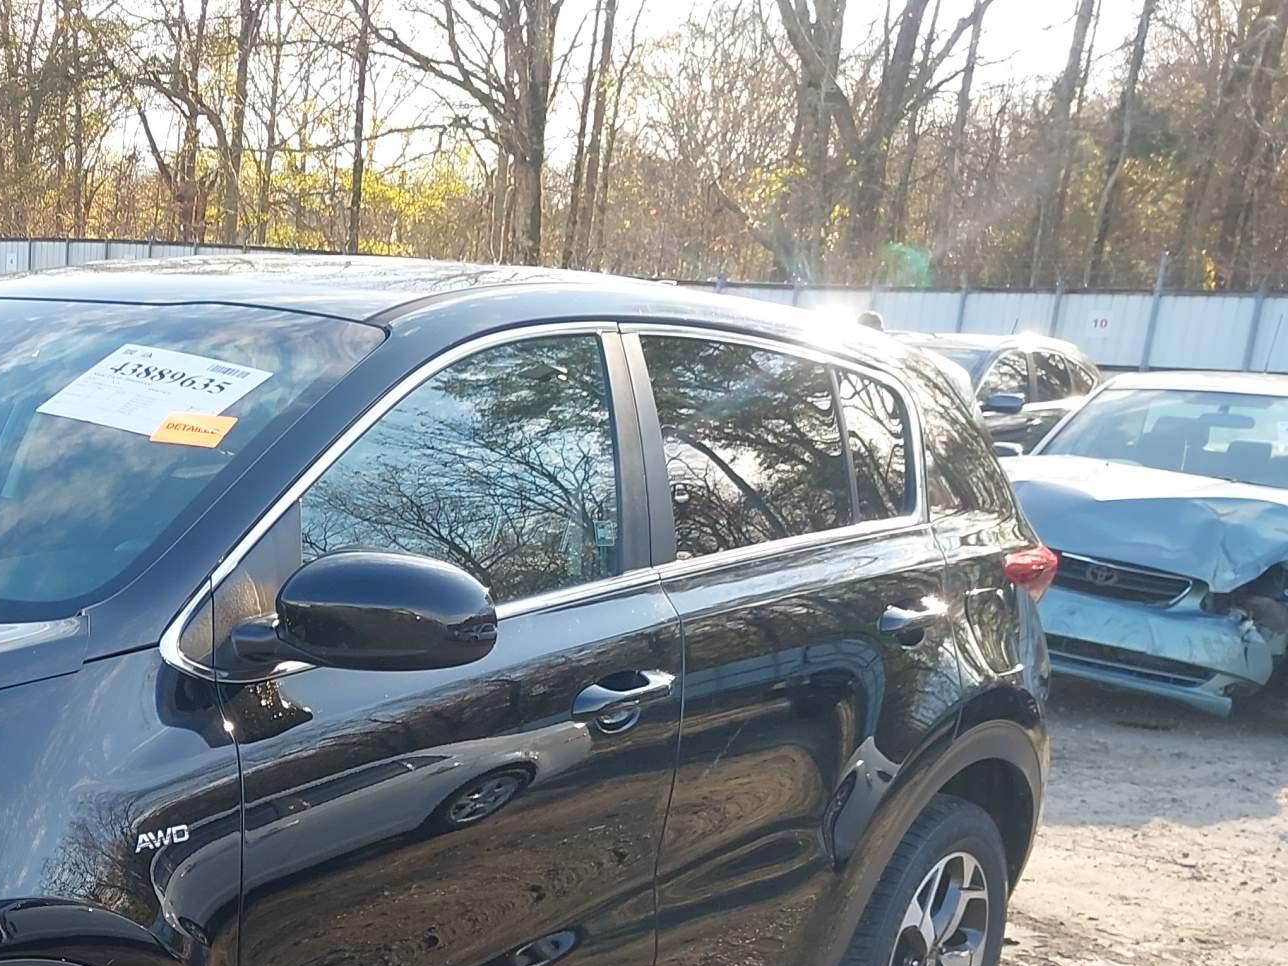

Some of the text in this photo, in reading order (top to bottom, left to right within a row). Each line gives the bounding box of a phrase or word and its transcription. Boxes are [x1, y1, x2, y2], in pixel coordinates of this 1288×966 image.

[1093, 318, 1108, 329] 10
[109, 361, 233, 395] 43889635
[135, 824, 190, 853] AWD
